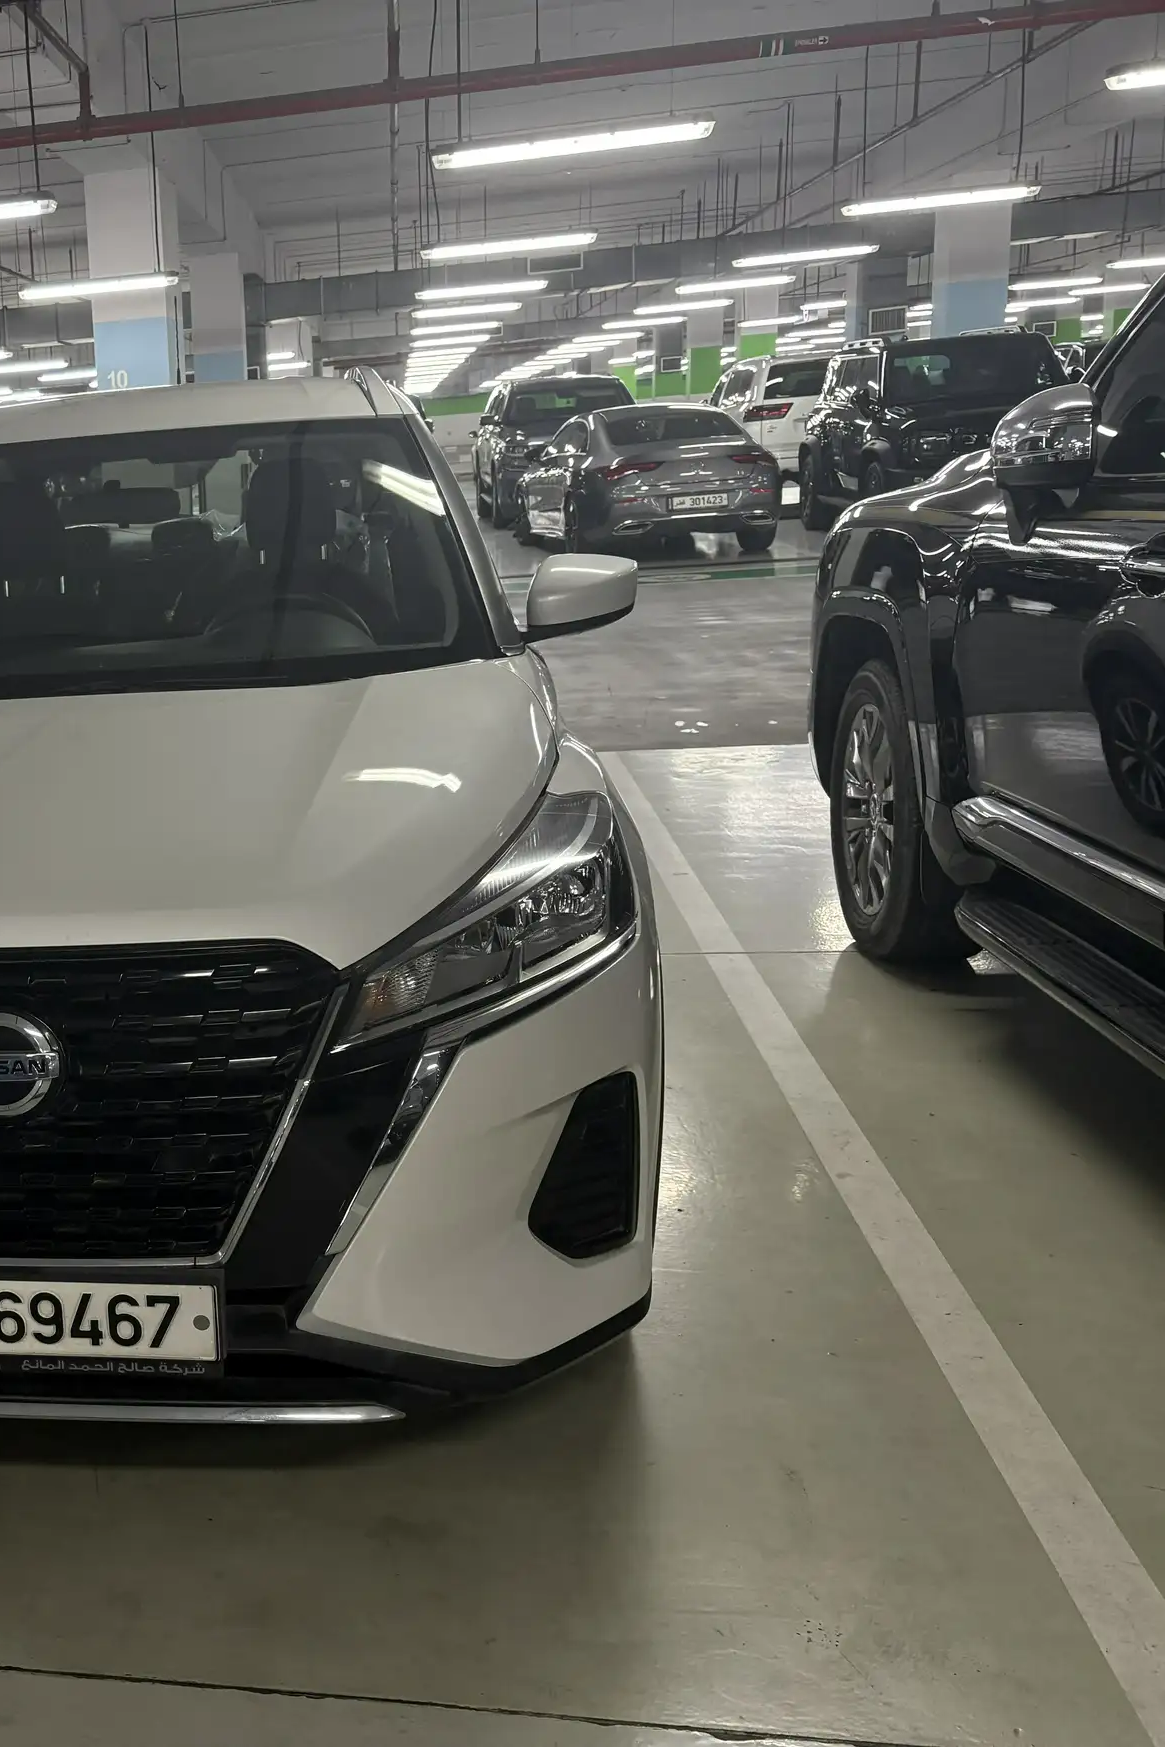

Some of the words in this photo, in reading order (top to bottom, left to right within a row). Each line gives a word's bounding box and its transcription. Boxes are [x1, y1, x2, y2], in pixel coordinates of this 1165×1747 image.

[107, 370, 128, 389] 10
[689, 495, 723, 506] 301423
[22, 1360, 65, 1371] المانع
[69, 1361, 114, 1371] الحمد
[118, 1362, 155, 1374] صالح
[159, 1361, 205, 1375] شركة
